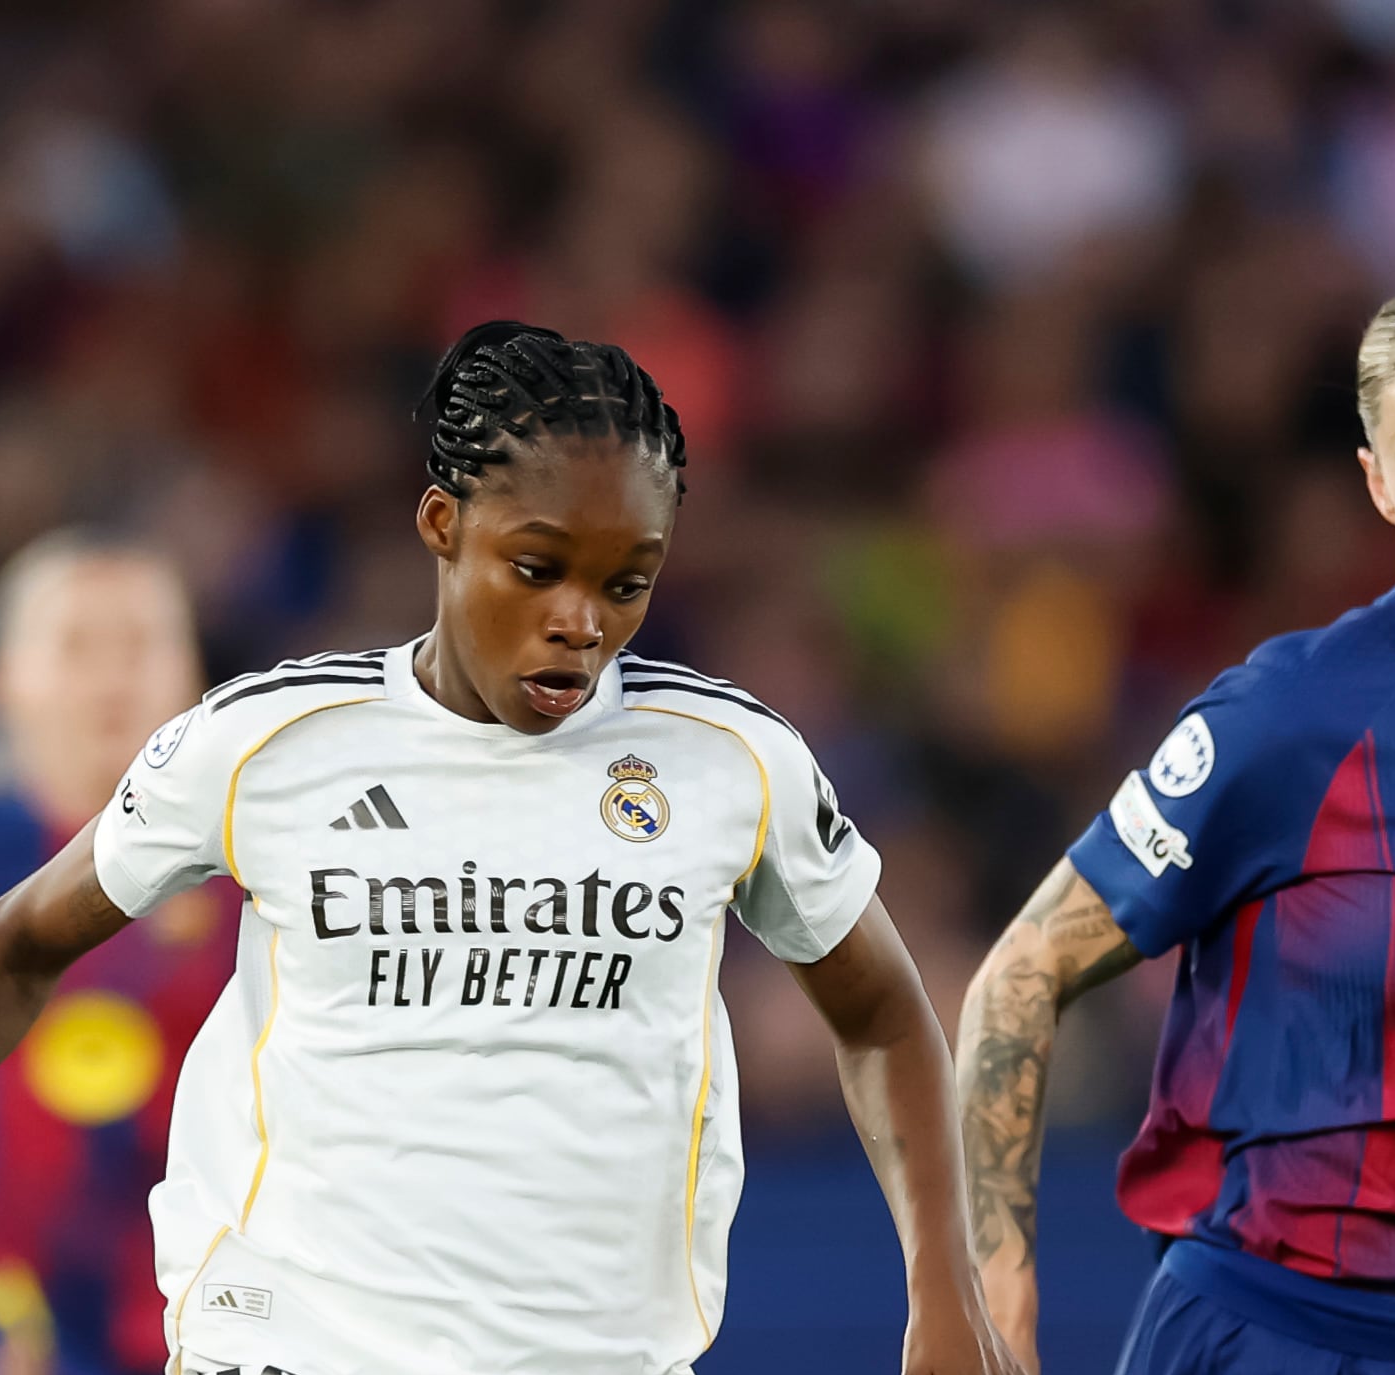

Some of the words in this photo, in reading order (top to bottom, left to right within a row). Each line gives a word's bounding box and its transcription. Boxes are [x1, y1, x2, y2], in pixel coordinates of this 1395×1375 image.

[309, 860, 685, 942] Emirates
[367, 948, 444, 1006] FLY
[460, 947, 633, 1009] BETTER
